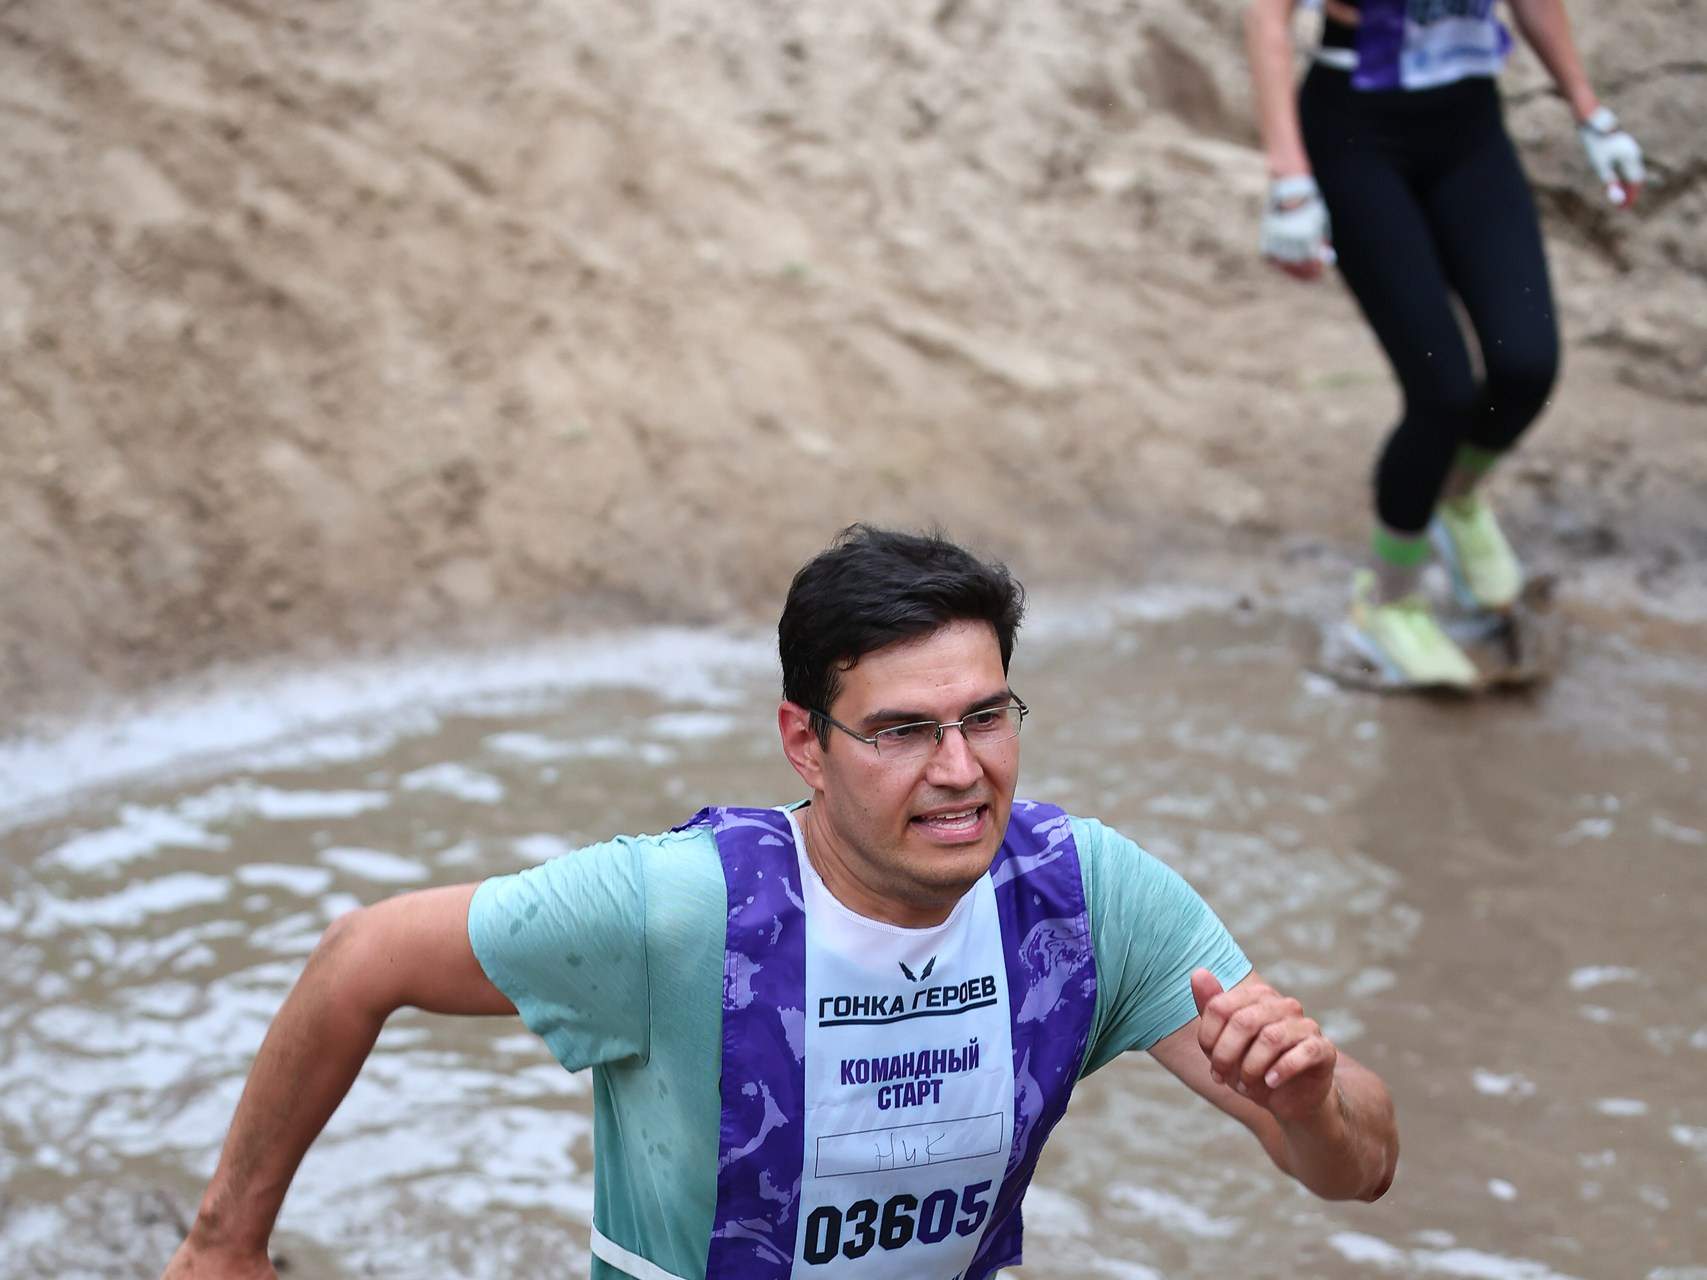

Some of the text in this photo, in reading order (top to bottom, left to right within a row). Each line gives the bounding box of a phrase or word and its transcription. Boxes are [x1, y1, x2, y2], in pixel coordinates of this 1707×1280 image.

[818, 975, 997, 1018] ГОНКА ГЕРОЕВ
[840, 1037, 980, 1085] КОМАНДНЫЙ
[877, 1079, 943, 1111] СТАРТ
[803, 1179, 993, 1266] 03605
